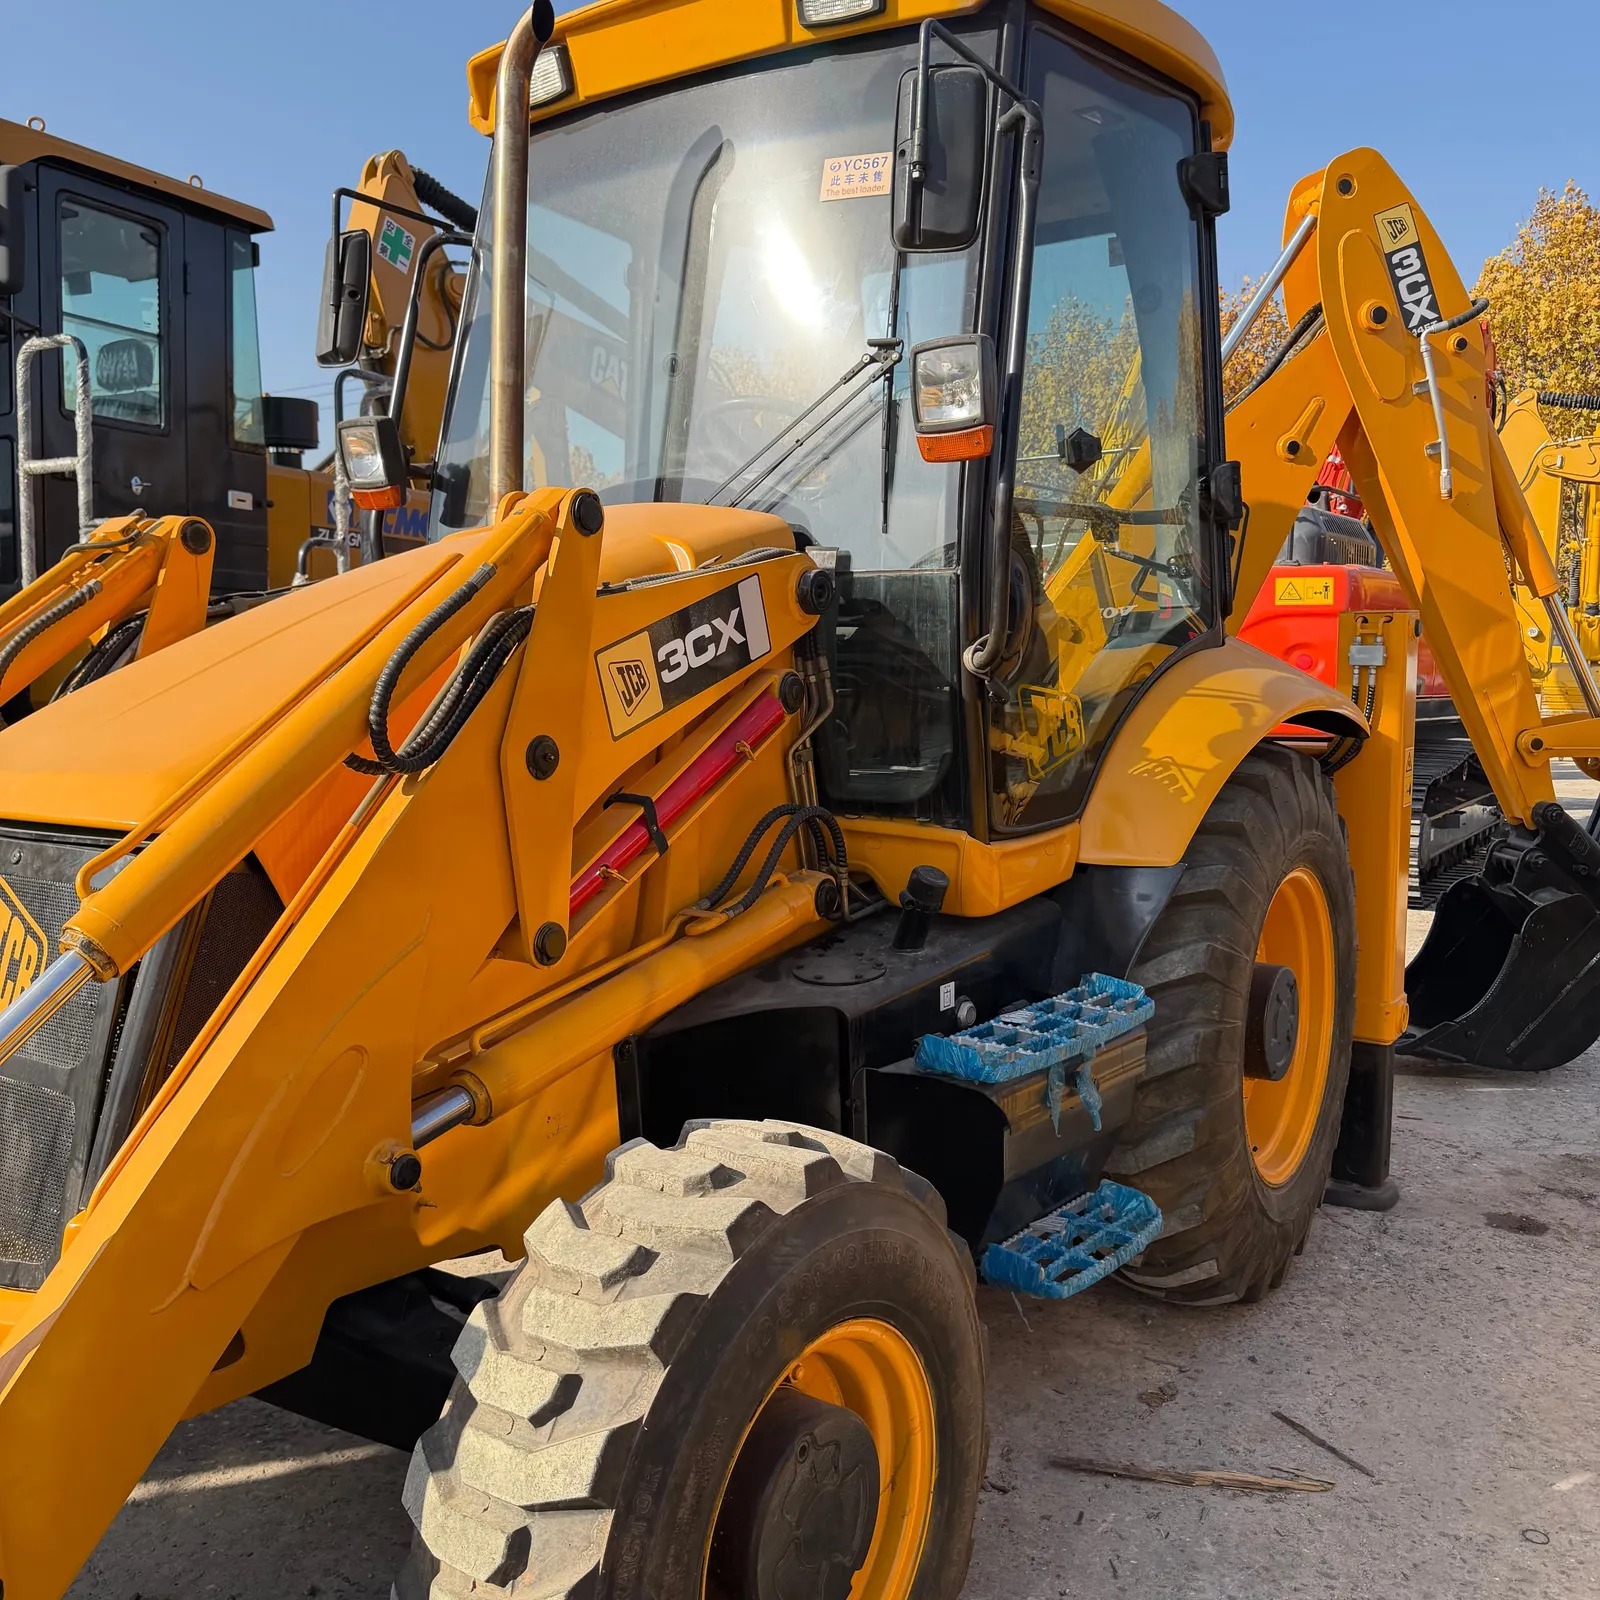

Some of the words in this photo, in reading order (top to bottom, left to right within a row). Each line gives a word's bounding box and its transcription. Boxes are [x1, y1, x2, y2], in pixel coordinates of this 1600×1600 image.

[843, 156, 889, 171] YC567
[830, 170, 884, 187] 此车未售
[825, 188, 840, 197] The
[841, 186, 859, 196] best
[860, 184, 885, 194] loader
[1386, 218, 1408, 241] JCB
[1391, 247, 1440, 329] 3CX
[657, 606, 747, 684] 3CX
[615, 663, 648, 710] JCB
